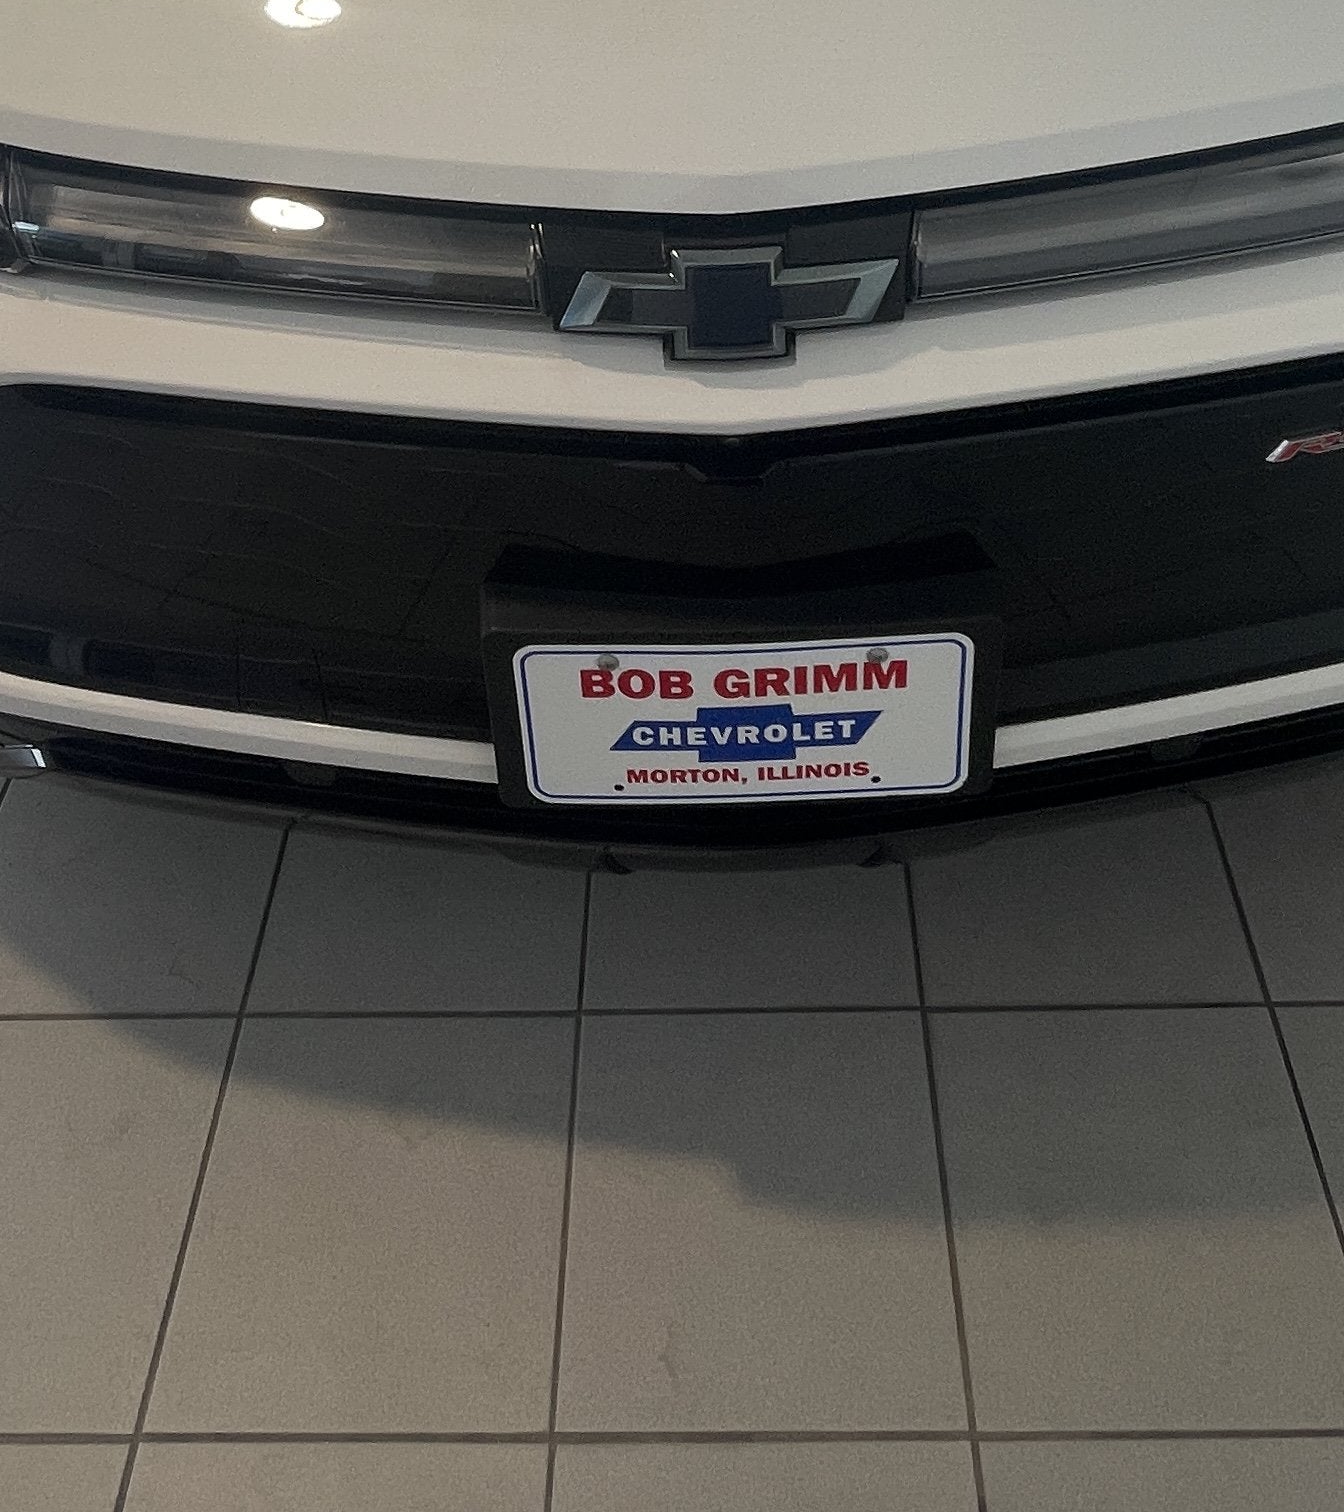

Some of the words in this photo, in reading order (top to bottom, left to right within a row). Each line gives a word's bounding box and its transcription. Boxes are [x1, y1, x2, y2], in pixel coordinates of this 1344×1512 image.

[580, 669, 694, 699] BOB
[714, 660, 908, 699] GRIMM
[632, 720, 856, 746] CHEVROLET
[626, 768, 748, 785] MORTON,
[758, 761, 870, 781] ILLINOIS
